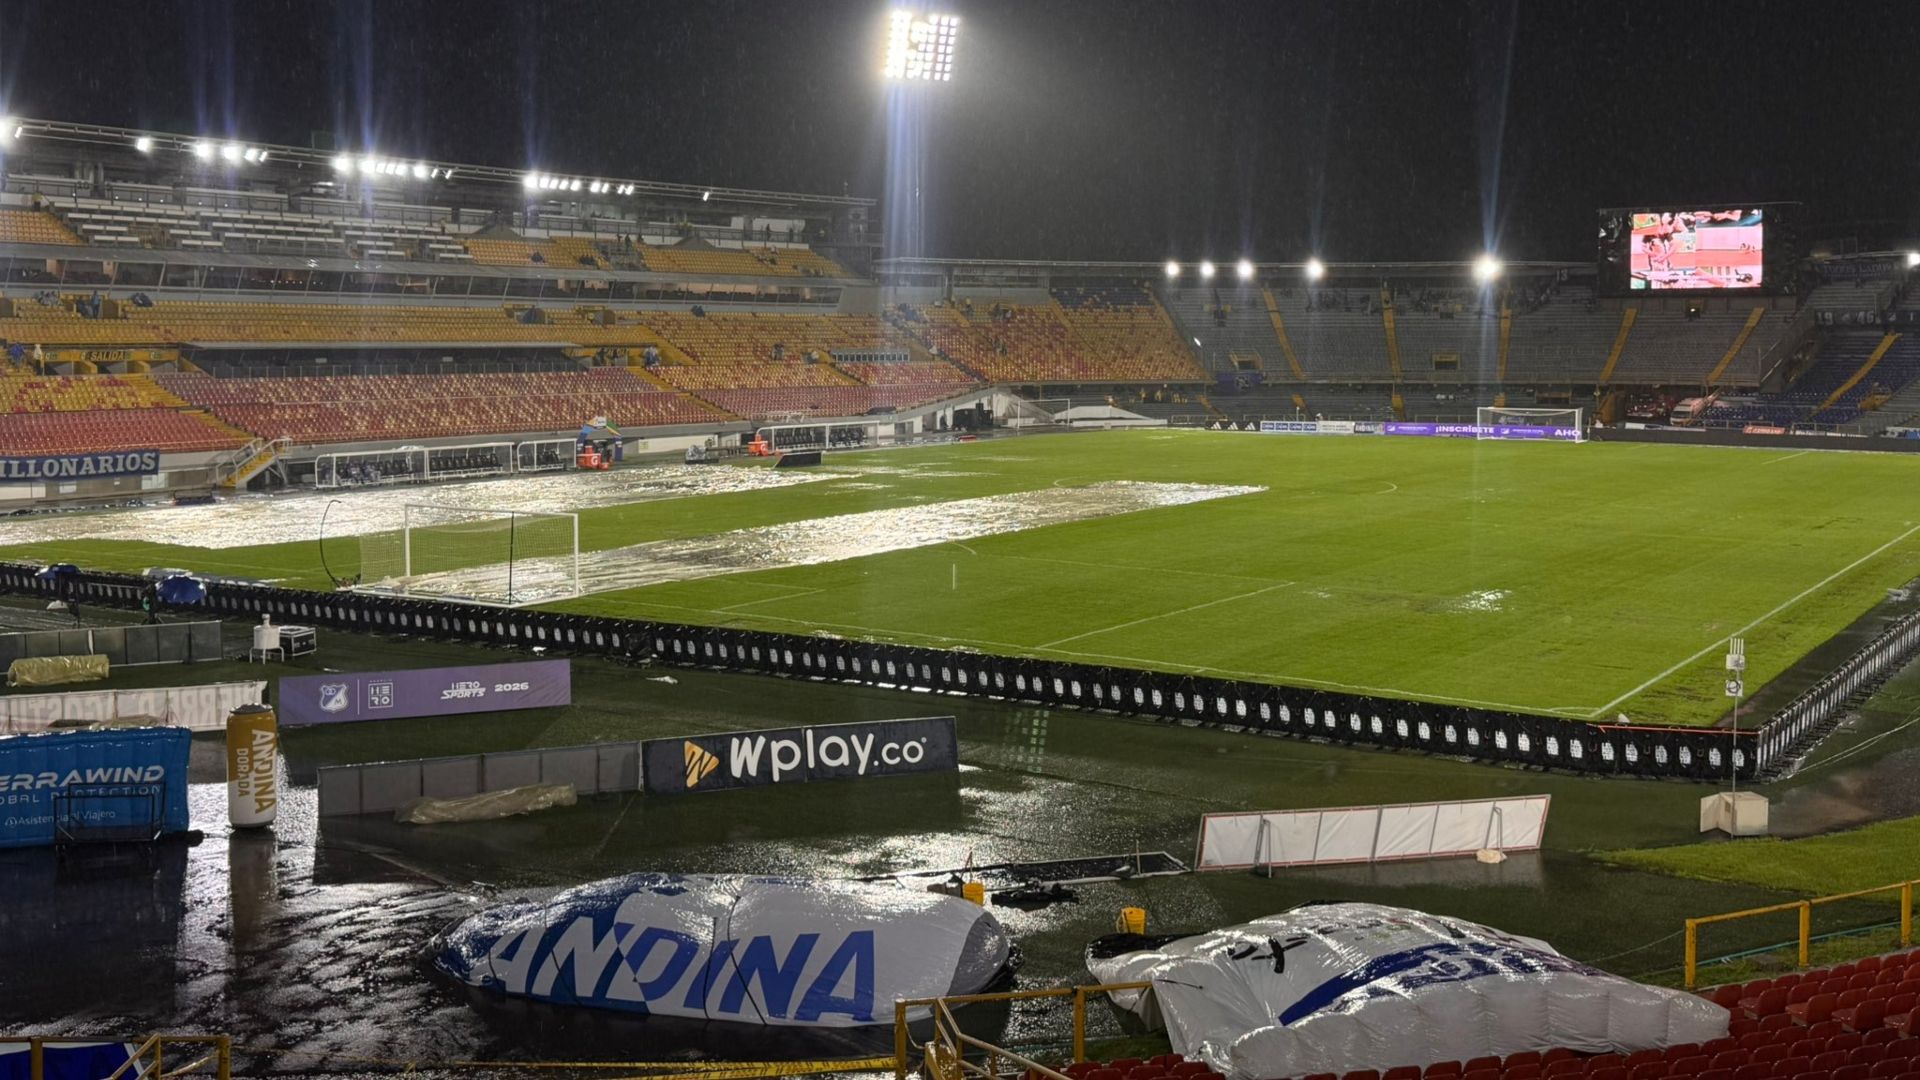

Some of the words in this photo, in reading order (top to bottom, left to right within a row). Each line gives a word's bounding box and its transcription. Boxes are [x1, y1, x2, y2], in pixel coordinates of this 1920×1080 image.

[90, 351, 126, 361] SALIDA
[494, 682, 529, 693] 2026
[236, 748, 250, 798] DORADA
[252, 729, 276, 814] ANDINA
[81, 808, 116, 821] Viajero
[466, 917, 875, 1021] ANDINA
